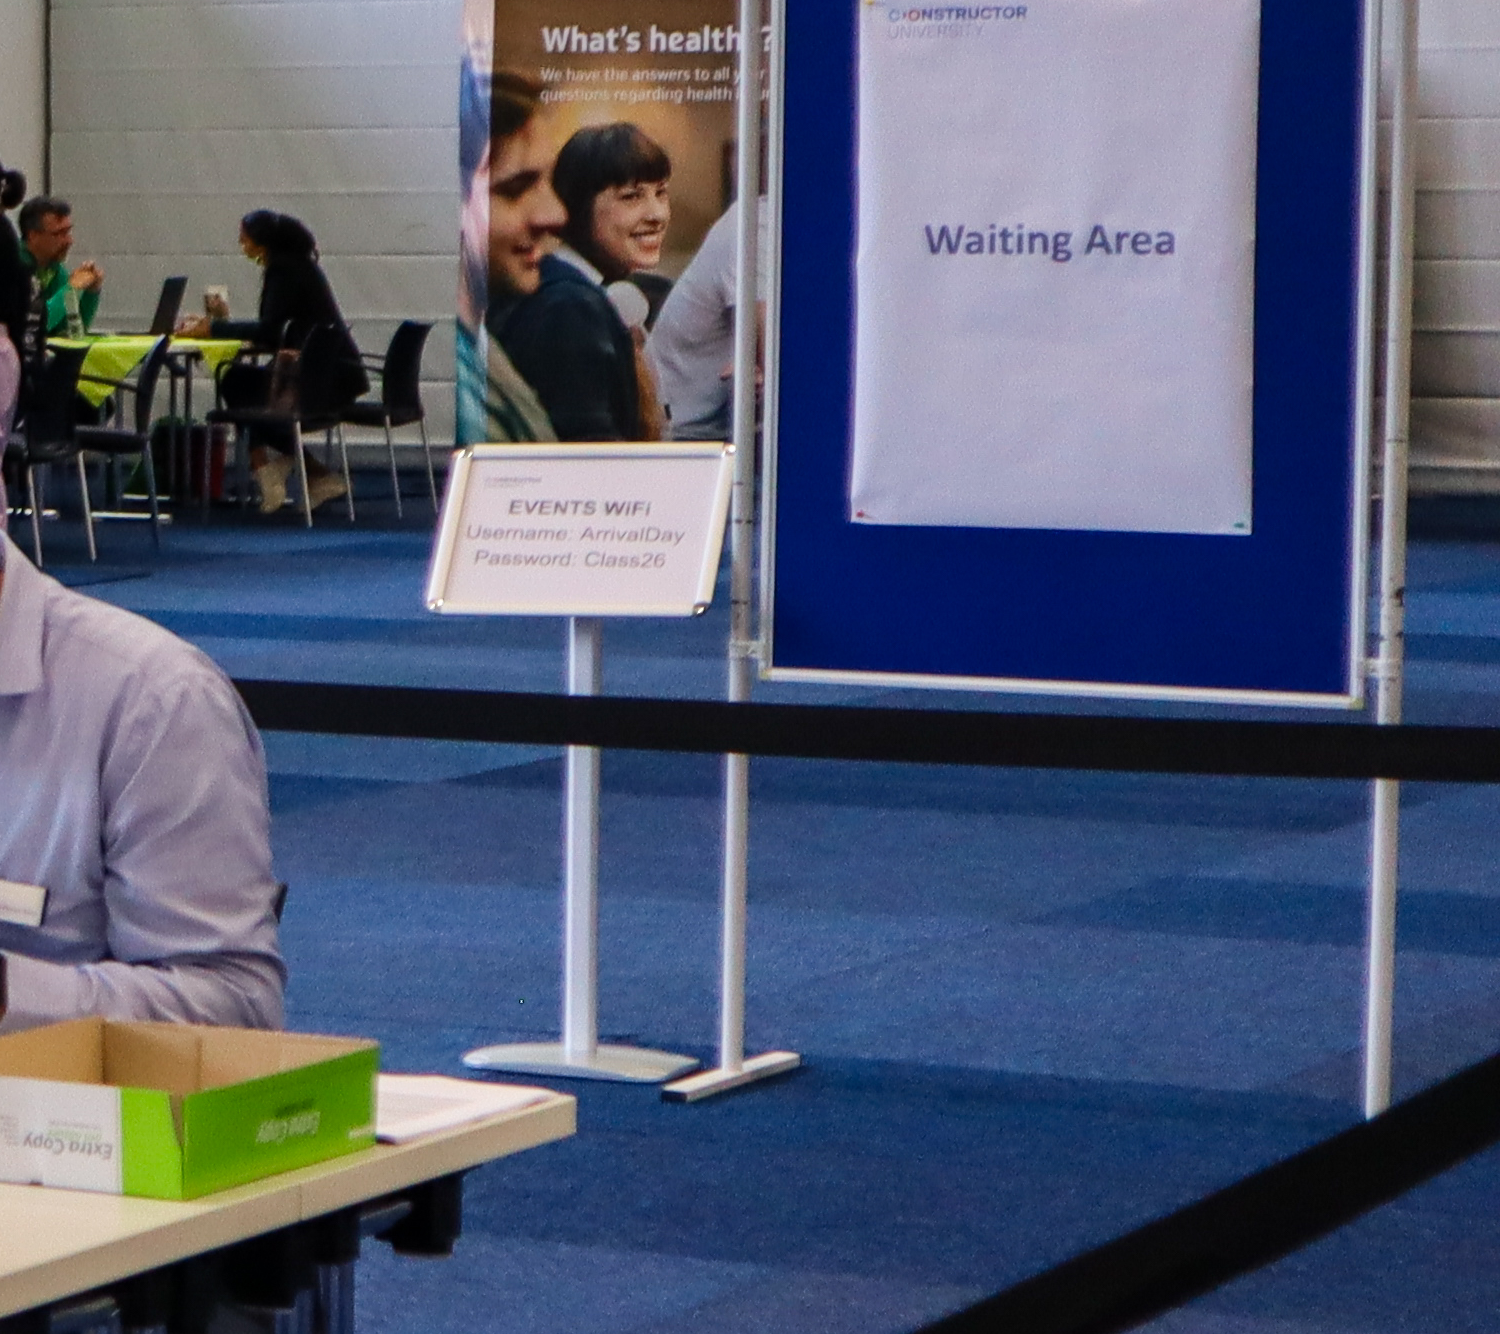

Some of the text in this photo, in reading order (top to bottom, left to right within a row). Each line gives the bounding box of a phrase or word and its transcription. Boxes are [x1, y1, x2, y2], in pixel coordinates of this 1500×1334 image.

[541, 24, 642, 53] What's
[887, 24, 984, 40] UNIVERSITY
[540, 67, 560, 81] We
[604, 67, 628, 81] the
[631, 68, 691, 81] answers
[695, 68, 709, 81] to
[713, 66, 731, 81] all
[614, 86, 683, 104] regarding
[686, 85, 733, 101] health
[925, 223, 1176, 263] Waiting Area
[508, 499, 652, 517] EVENTS WiFi
[466, 524, 686, 546] Username: ArrivalDay
[474, 548, 667, 569] Password: Class26
[23, 1130, 66, 1155] Copy
[67, 1137, 114, 1160] Extra
